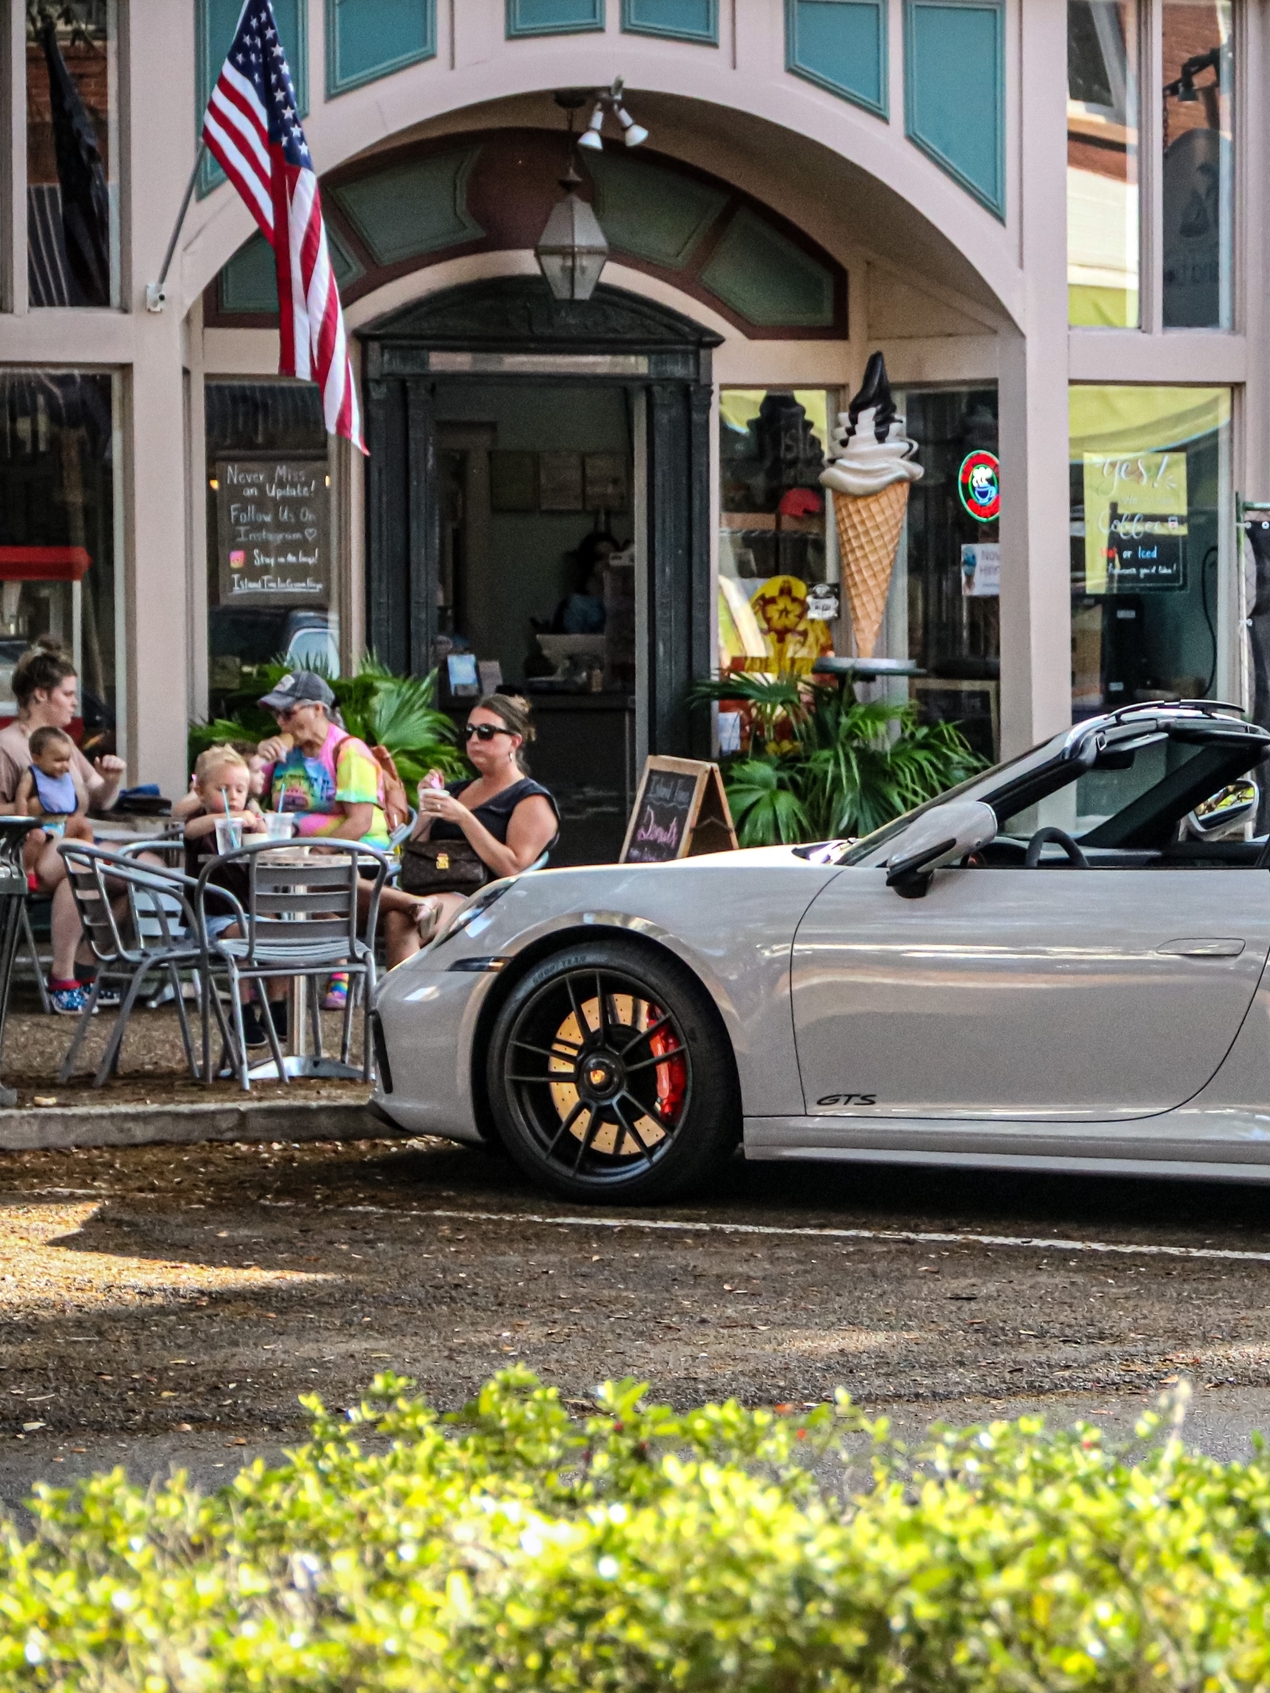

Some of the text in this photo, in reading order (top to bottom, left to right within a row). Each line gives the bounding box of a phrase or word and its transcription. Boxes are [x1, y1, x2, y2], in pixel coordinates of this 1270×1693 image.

[226, 463, 306, 485] Never Miss
[242, 479, 316, 501] an Update!
[230, 502, 317, 525] Follow Us On
[235, 525, 303, 544] Instagram
[1098, 512, 1162, 540] Coffee
[1122, 550, 1133, 559] or
[1138, 545, 1158, 559] Iced
[816, 1094, 877, 1106] GTS
